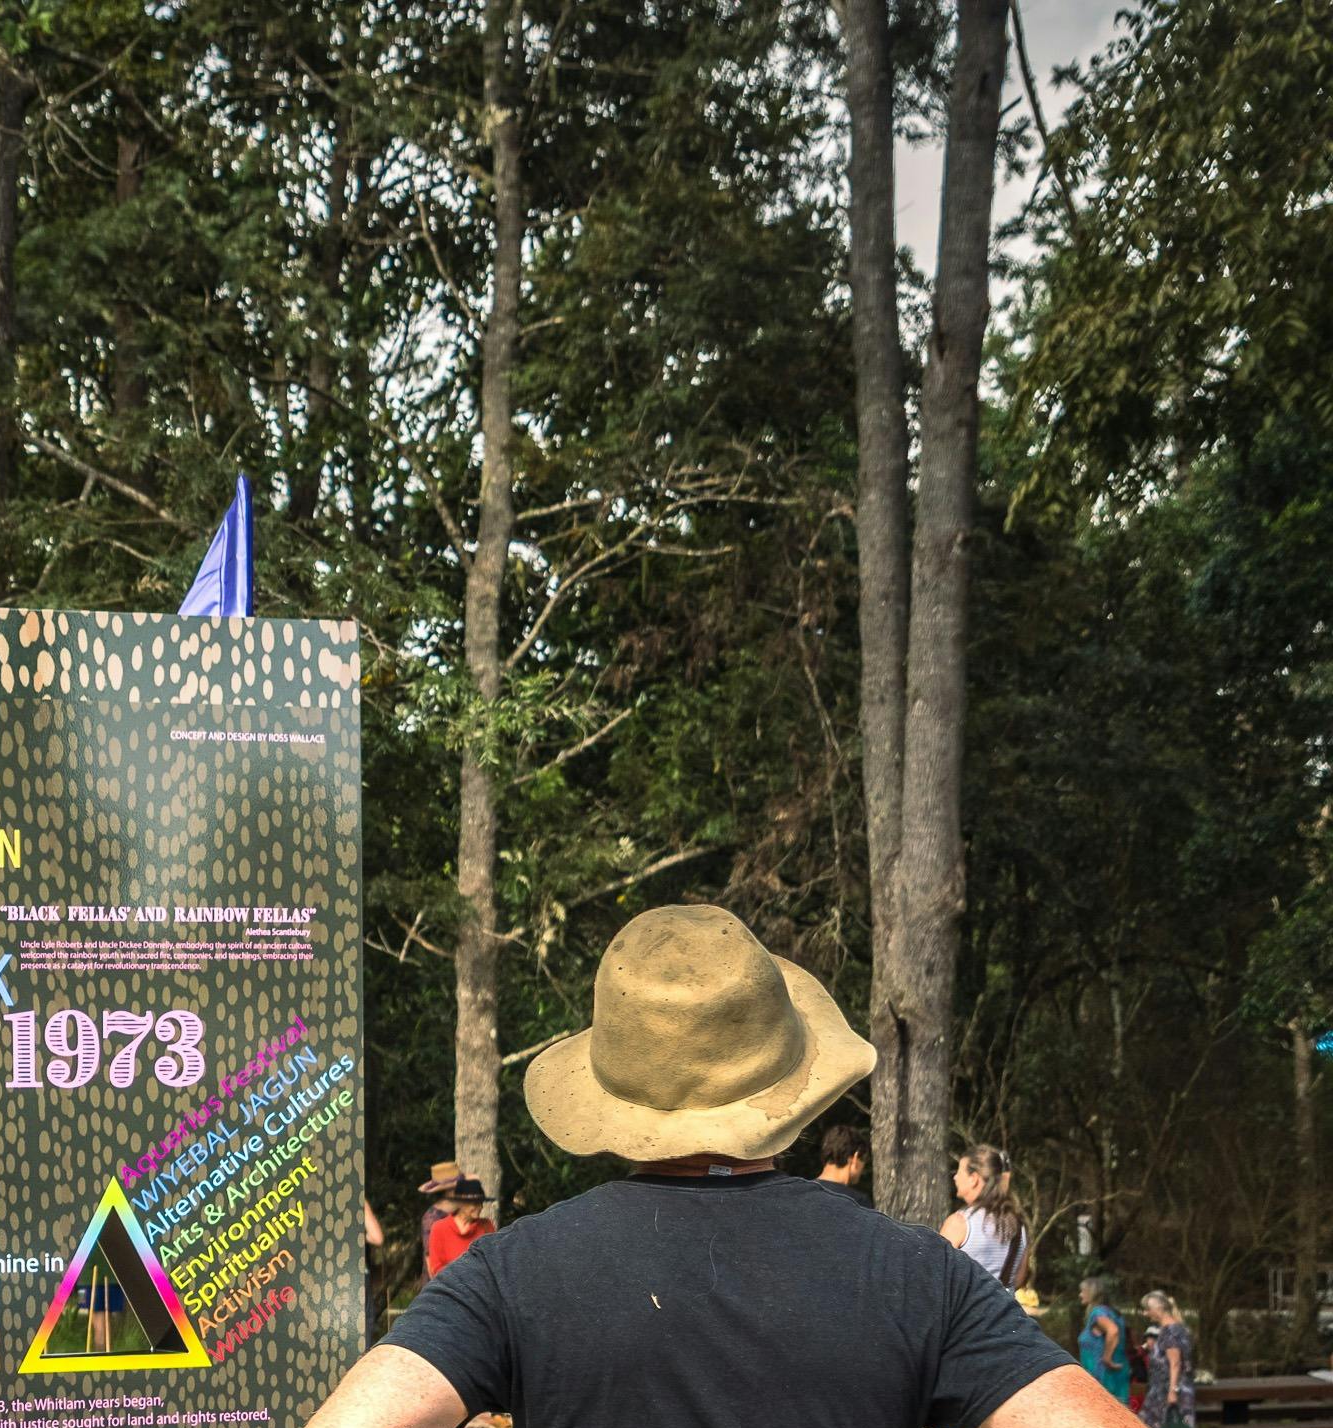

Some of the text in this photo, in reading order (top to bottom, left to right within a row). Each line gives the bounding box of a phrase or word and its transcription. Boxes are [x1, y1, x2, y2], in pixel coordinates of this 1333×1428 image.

[170, 731, 325, 743] CONCEPT AND DESIGN BY ROSS WALLACE
[0, 905, 316, 923] “BLACK FELLAS’ AND RAINBOW FELLAS”
[271, 928, 310, 937] Scantlebury
[20, 962, 51, 970] presence
[66, 962, 92, 970] catalyst
[104, 962, 150, 970] revolutionary
[3, 1008, 206, 1089] 1973
[121, 1015, 309, 1189] Aquarius Festival
[131, 1045, 318, 1212] WIYEBAL JAGUN
[145, 1054, 355, 1244] Alternative Cultures
[157, 1089, 354, 1268] Arts & Architecture
[44, 1252, 64, 1273] in
[169, 1156, 318, 1290] Environment
[183, 1200, 306, 1315] Spirituality
[196, 1249, 294, 1339] Activism
[206, 1285, 296, 1362] Wildlife
[11, 1398, 32, 1411] the
[33, 1396, 85, 1410] Whitlam
[88, 1397, 120, 1411] years
[123, 1394, 164, 1409] began,
[107, 1413, 125, 1426] for
[127, 1411, 153, 1425] land
[156, 1411, 179, 1424] and
[182, 1410, 216, 1426] rights
[219, 1407, 270, 1421] restored.
